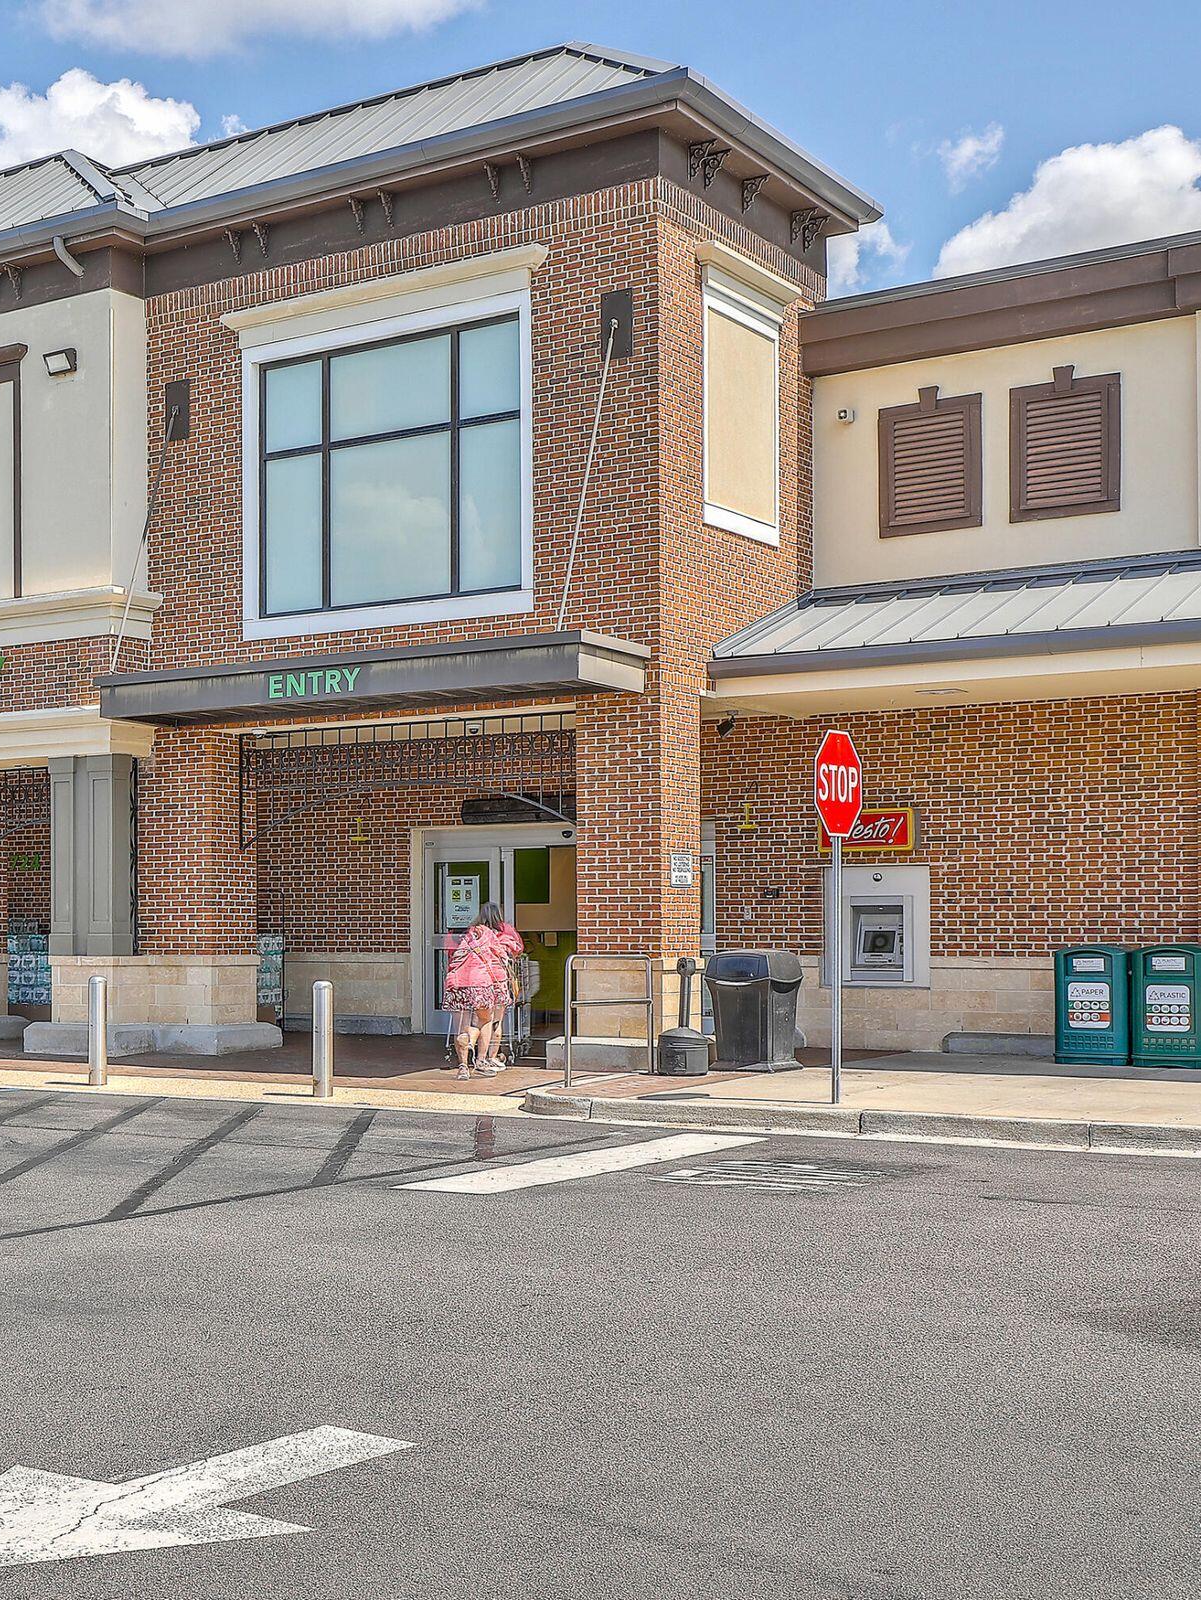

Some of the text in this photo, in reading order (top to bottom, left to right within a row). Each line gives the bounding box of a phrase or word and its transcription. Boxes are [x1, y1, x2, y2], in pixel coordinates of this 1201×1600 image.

[269, 667, 361, 698] ENTRY
[818, 763, 858, 803] STOP
[846, 816, 904, 844] esto!
